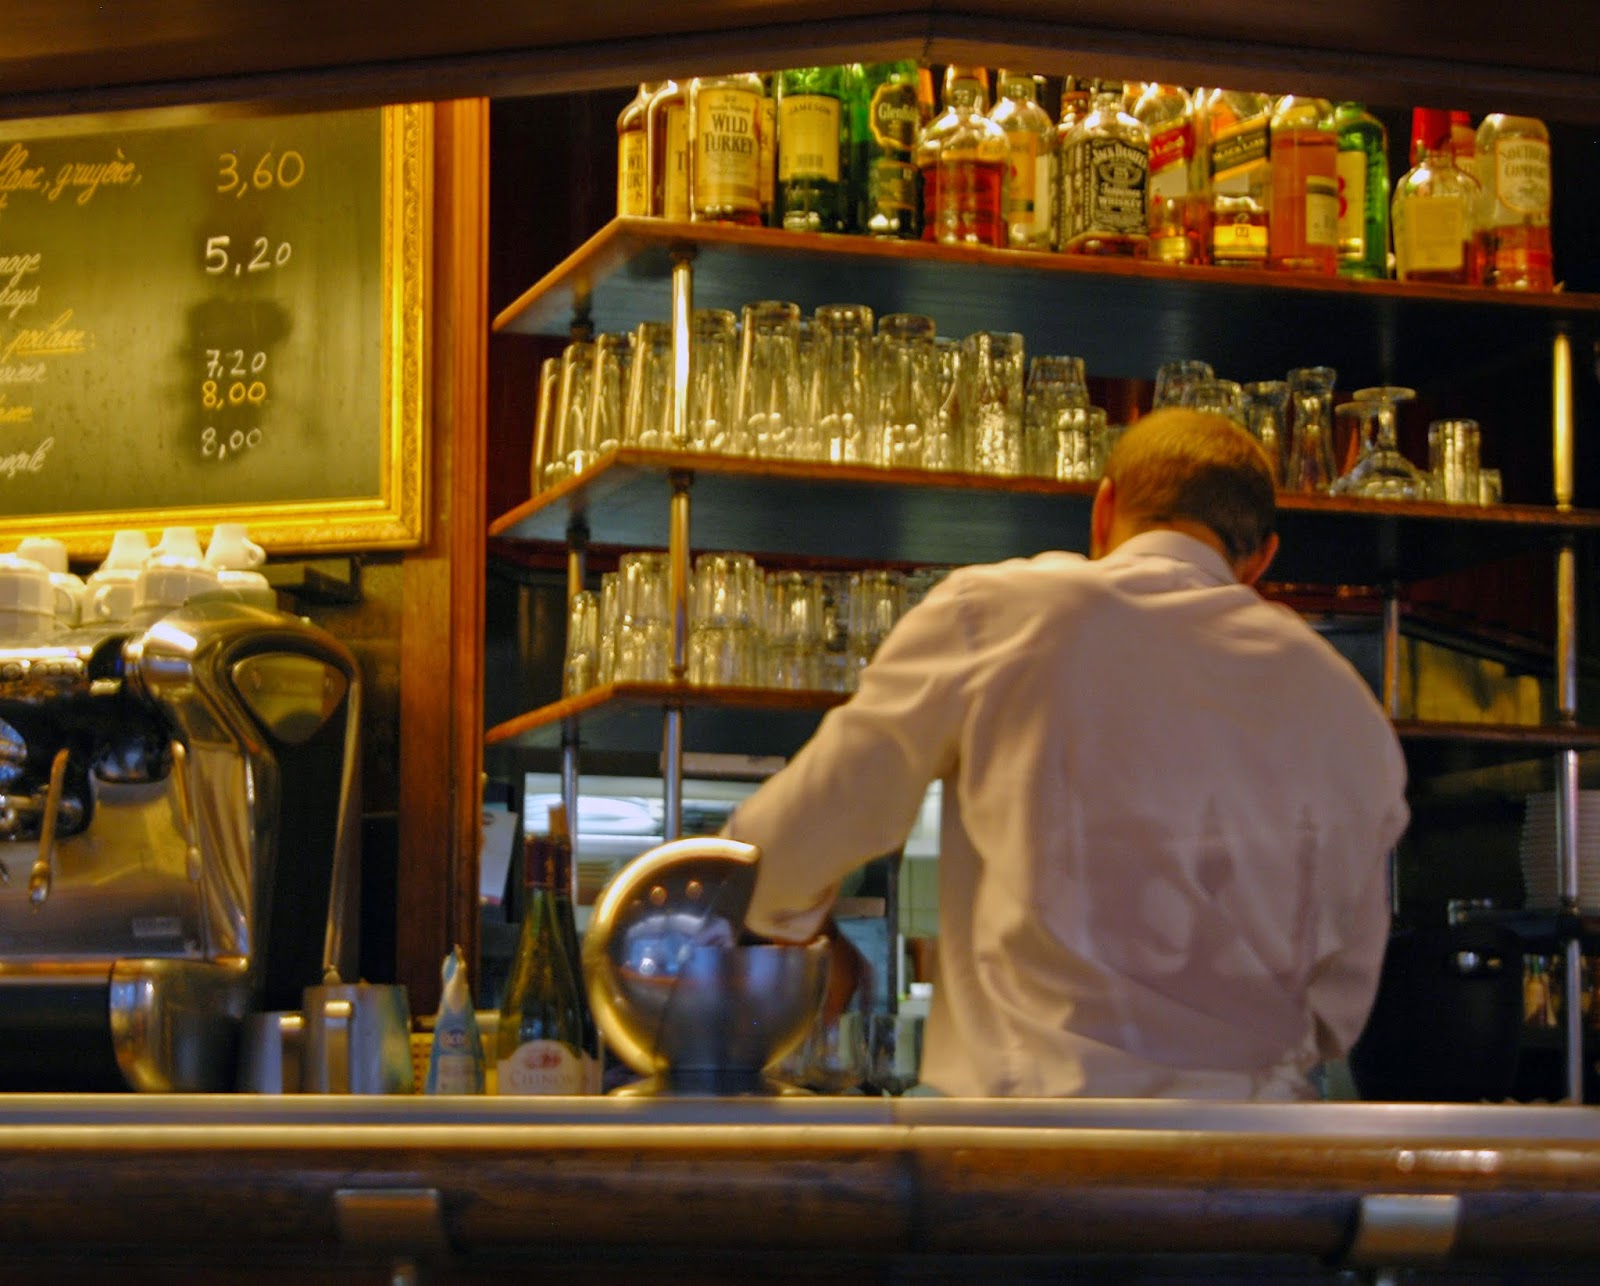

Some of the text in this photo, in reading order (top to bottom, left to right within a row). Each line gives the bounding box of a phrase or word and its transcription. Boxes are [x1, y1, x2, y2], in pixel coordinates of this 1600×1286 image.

[711, 113, 748, 134] WILD
[788, 102, 831, 116] JAMESON
[703, 132, 754, 157] TURKEY
[217, 150, 305, 198] 3,60
[205, 235, 292, 277] 5,20
[205, 349, 267, 378] 7,20
[202, 380, 267, 409] 8,00
[200, 426, 263, 460] 8,00
